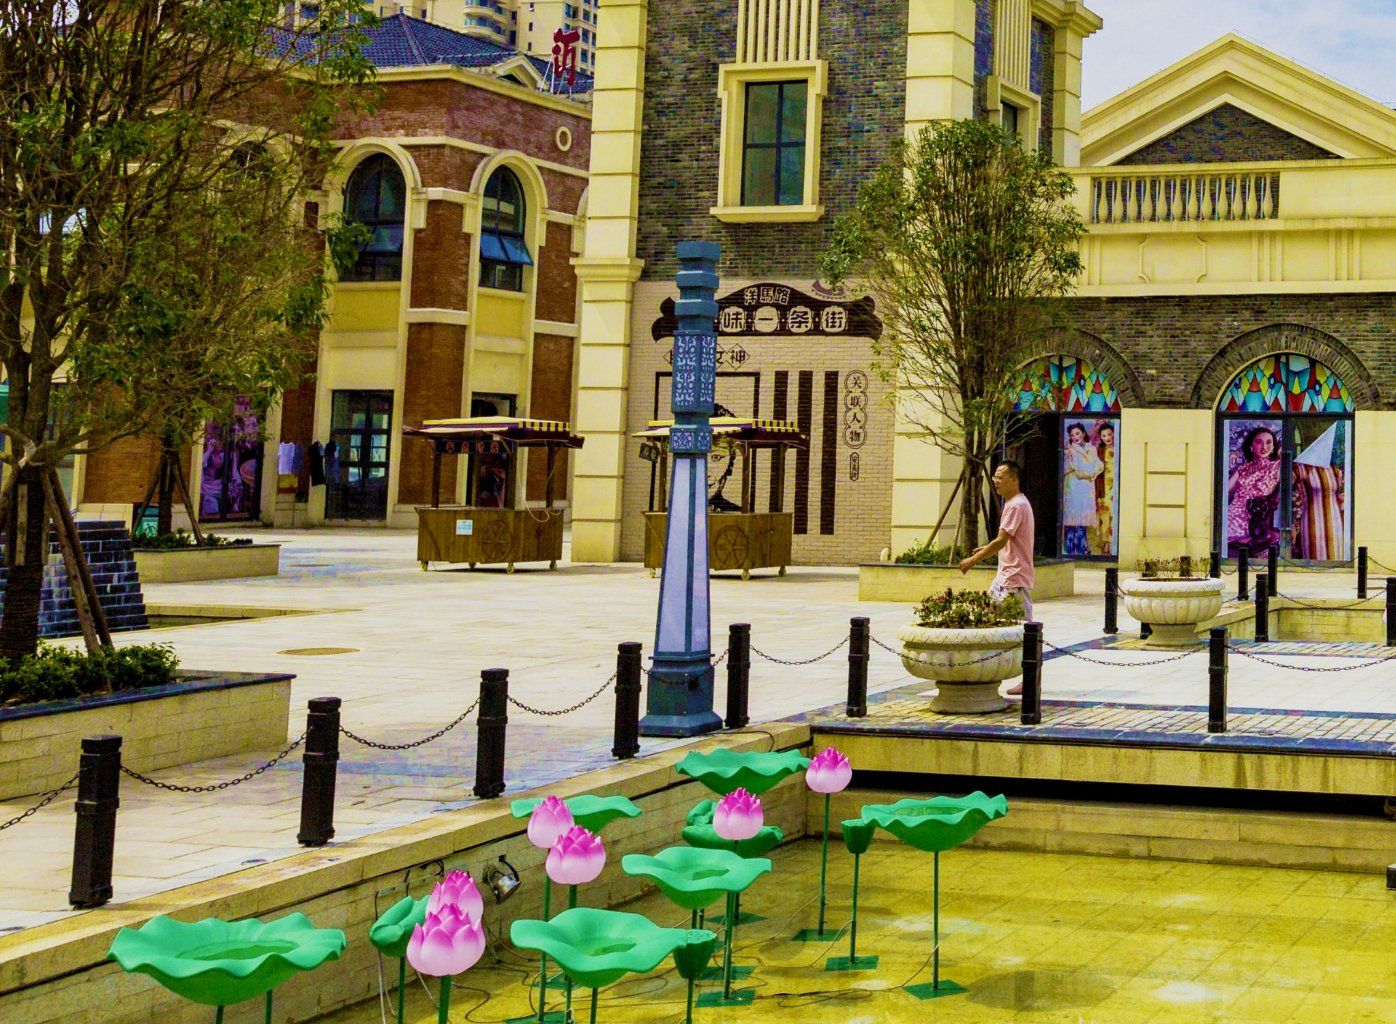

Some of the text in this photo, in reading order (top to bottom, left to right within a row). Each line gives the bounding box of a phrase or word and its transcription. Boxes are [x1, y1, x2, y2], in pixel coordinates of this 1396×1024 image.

[744, 286, 791, 306] 洋馬路
[722, 310, 845, 330] 味一条街
[849, 376, 862, 443] 关联人物
